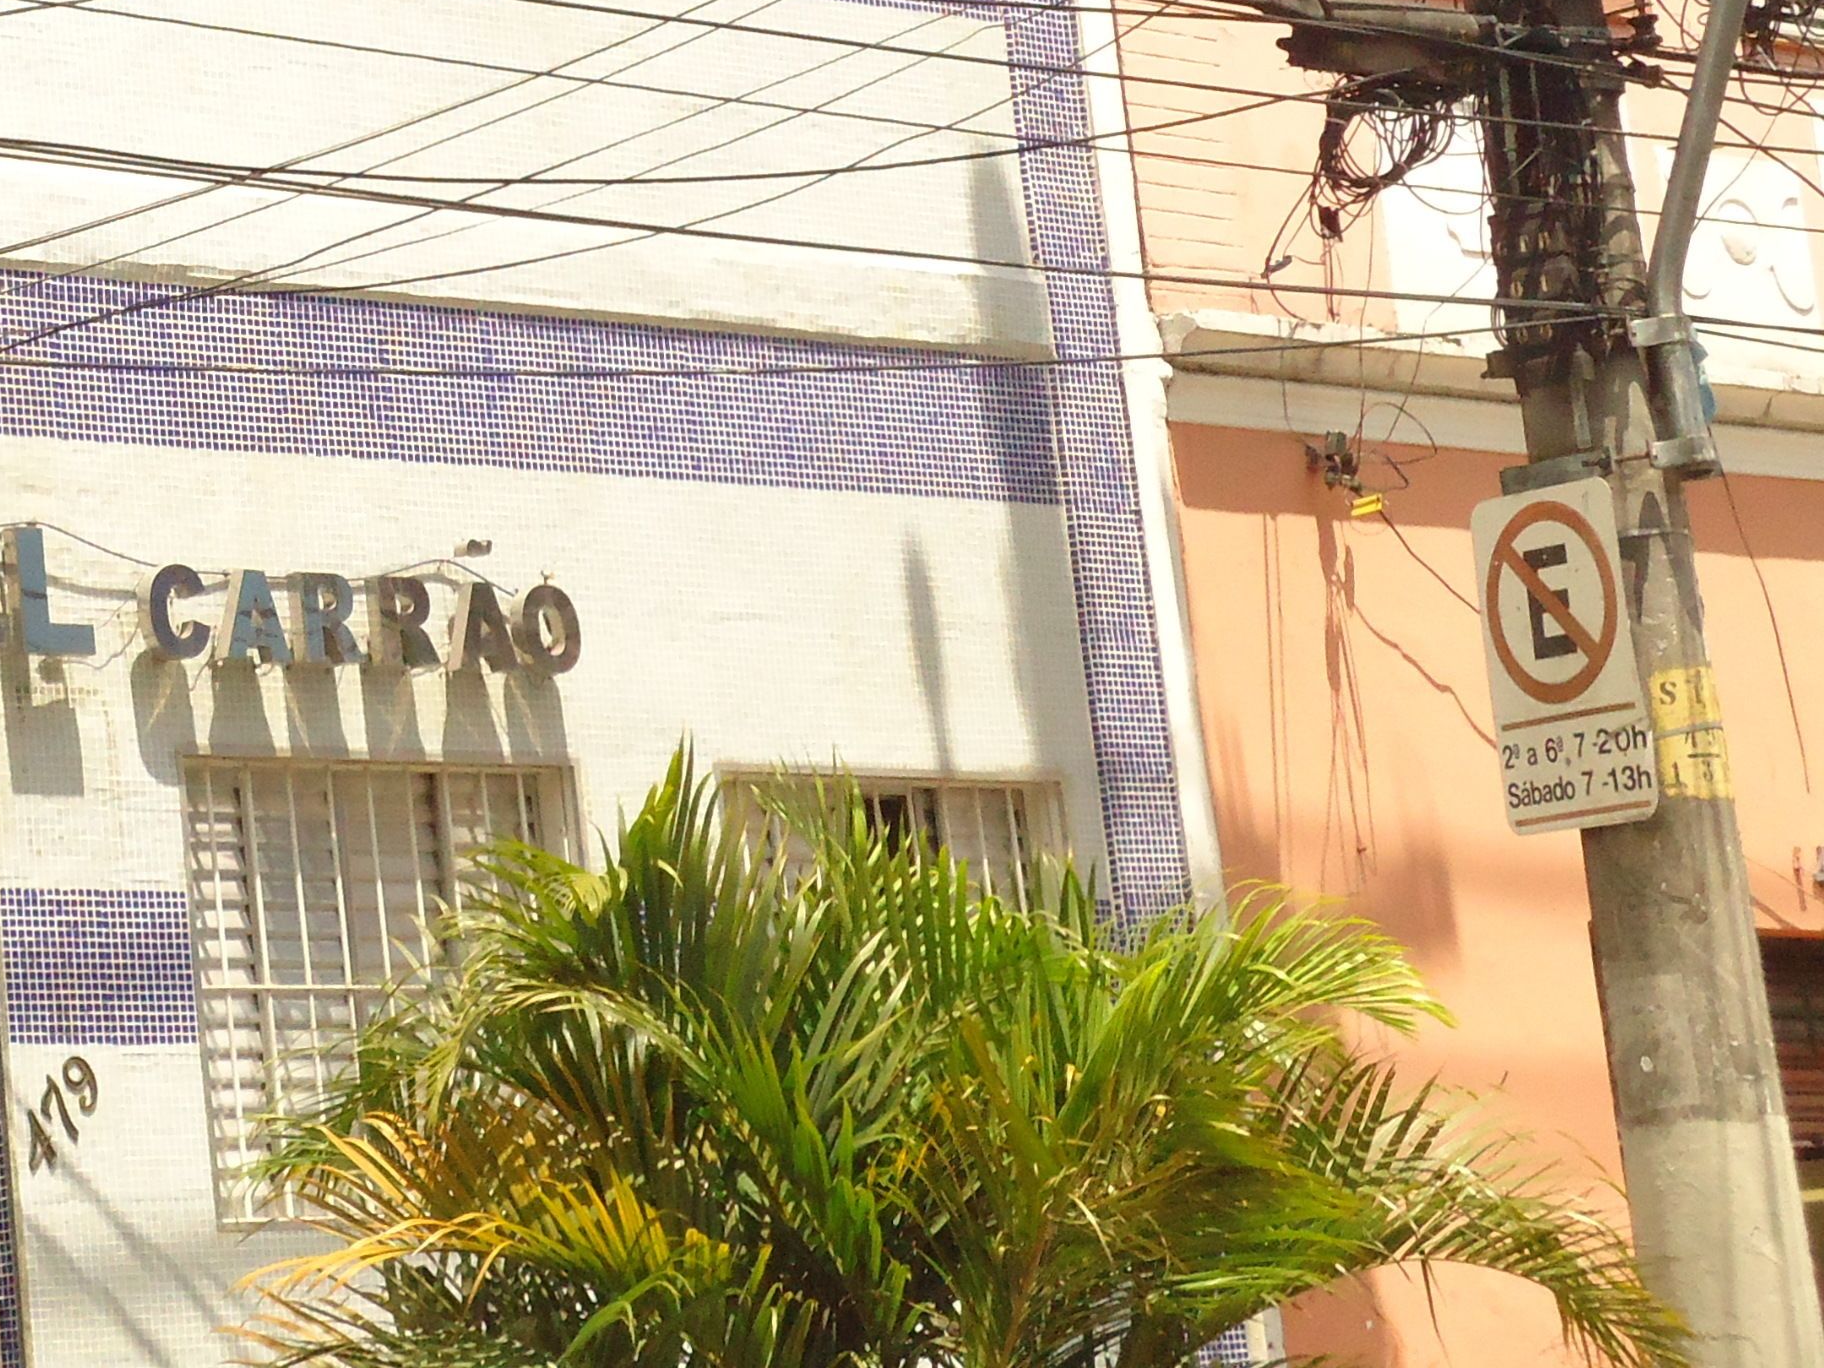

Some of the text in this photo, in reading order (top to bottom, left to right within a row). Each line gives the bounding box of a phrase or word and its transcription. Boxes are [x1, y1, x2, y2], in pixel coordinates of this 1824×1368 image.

[1526, 747, 1538, 766] a
[1508, 775, 1576, 809] Sábado
[27, 1056, 98, 1176] 479
